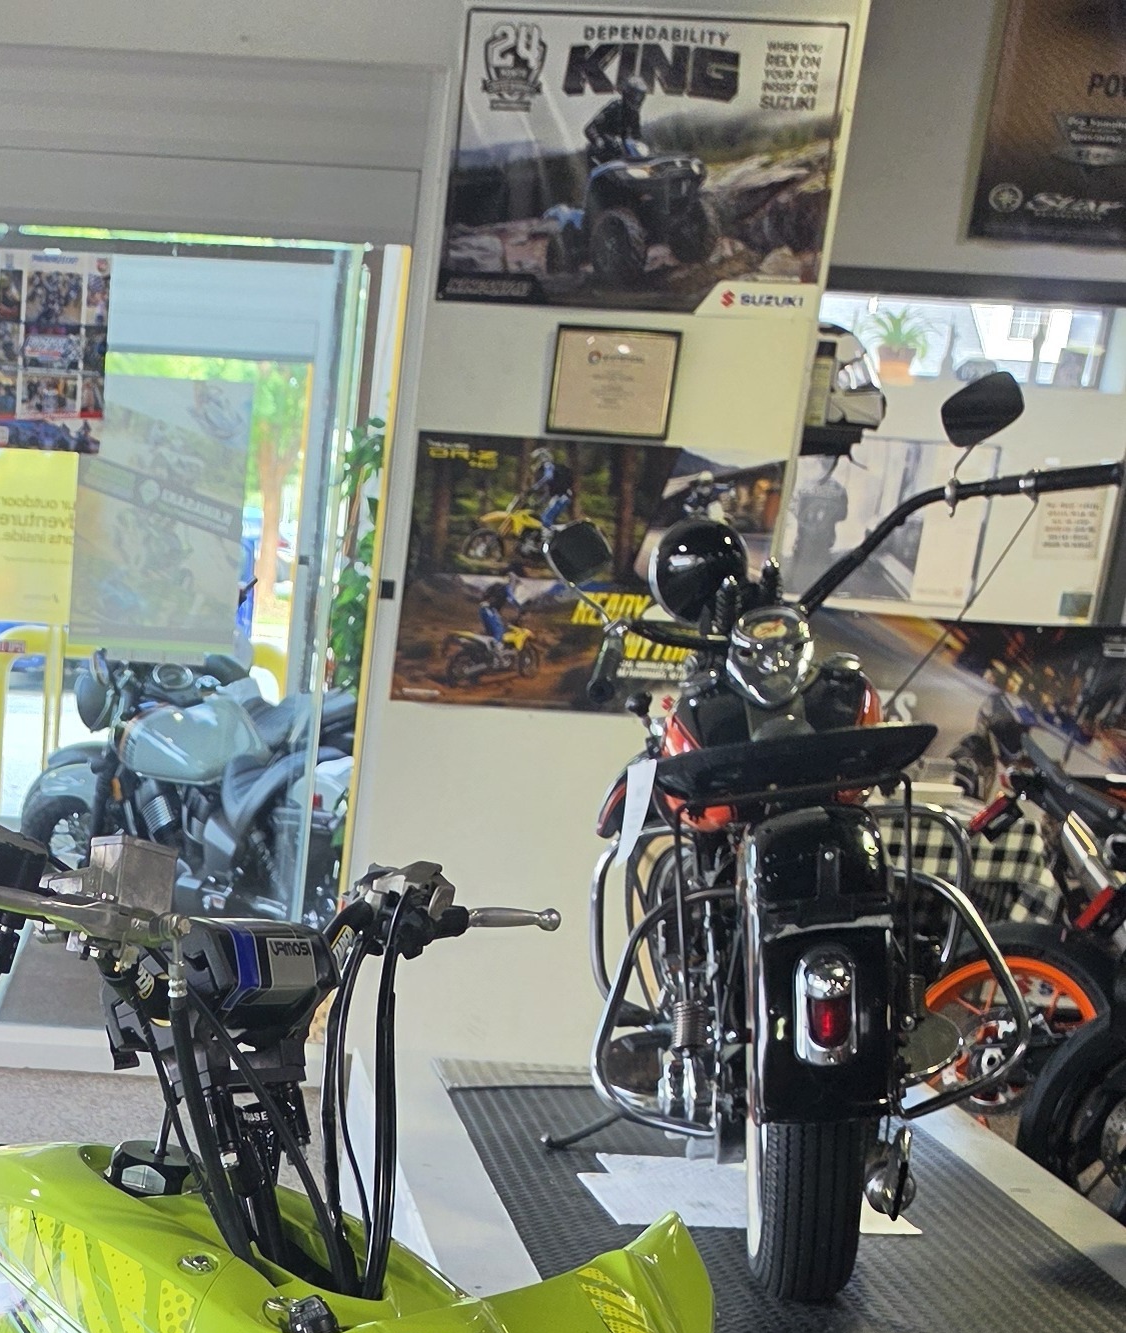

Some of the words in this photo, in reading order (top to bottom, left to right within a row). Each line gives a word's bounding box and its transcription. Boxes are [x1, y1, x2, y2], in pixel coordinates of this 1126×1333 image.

[583, 24, 731, 46] DEPENDABILITY
[492, 23, 542, 70] 24
[800, 54, 822, 69] ON
[562, 43, 741, 104] KING
[1086, 72, 1126, 98] PO
[758, 94, 816, 111] SUZUKI
[740, 292, 804, 308] SUZUKI
